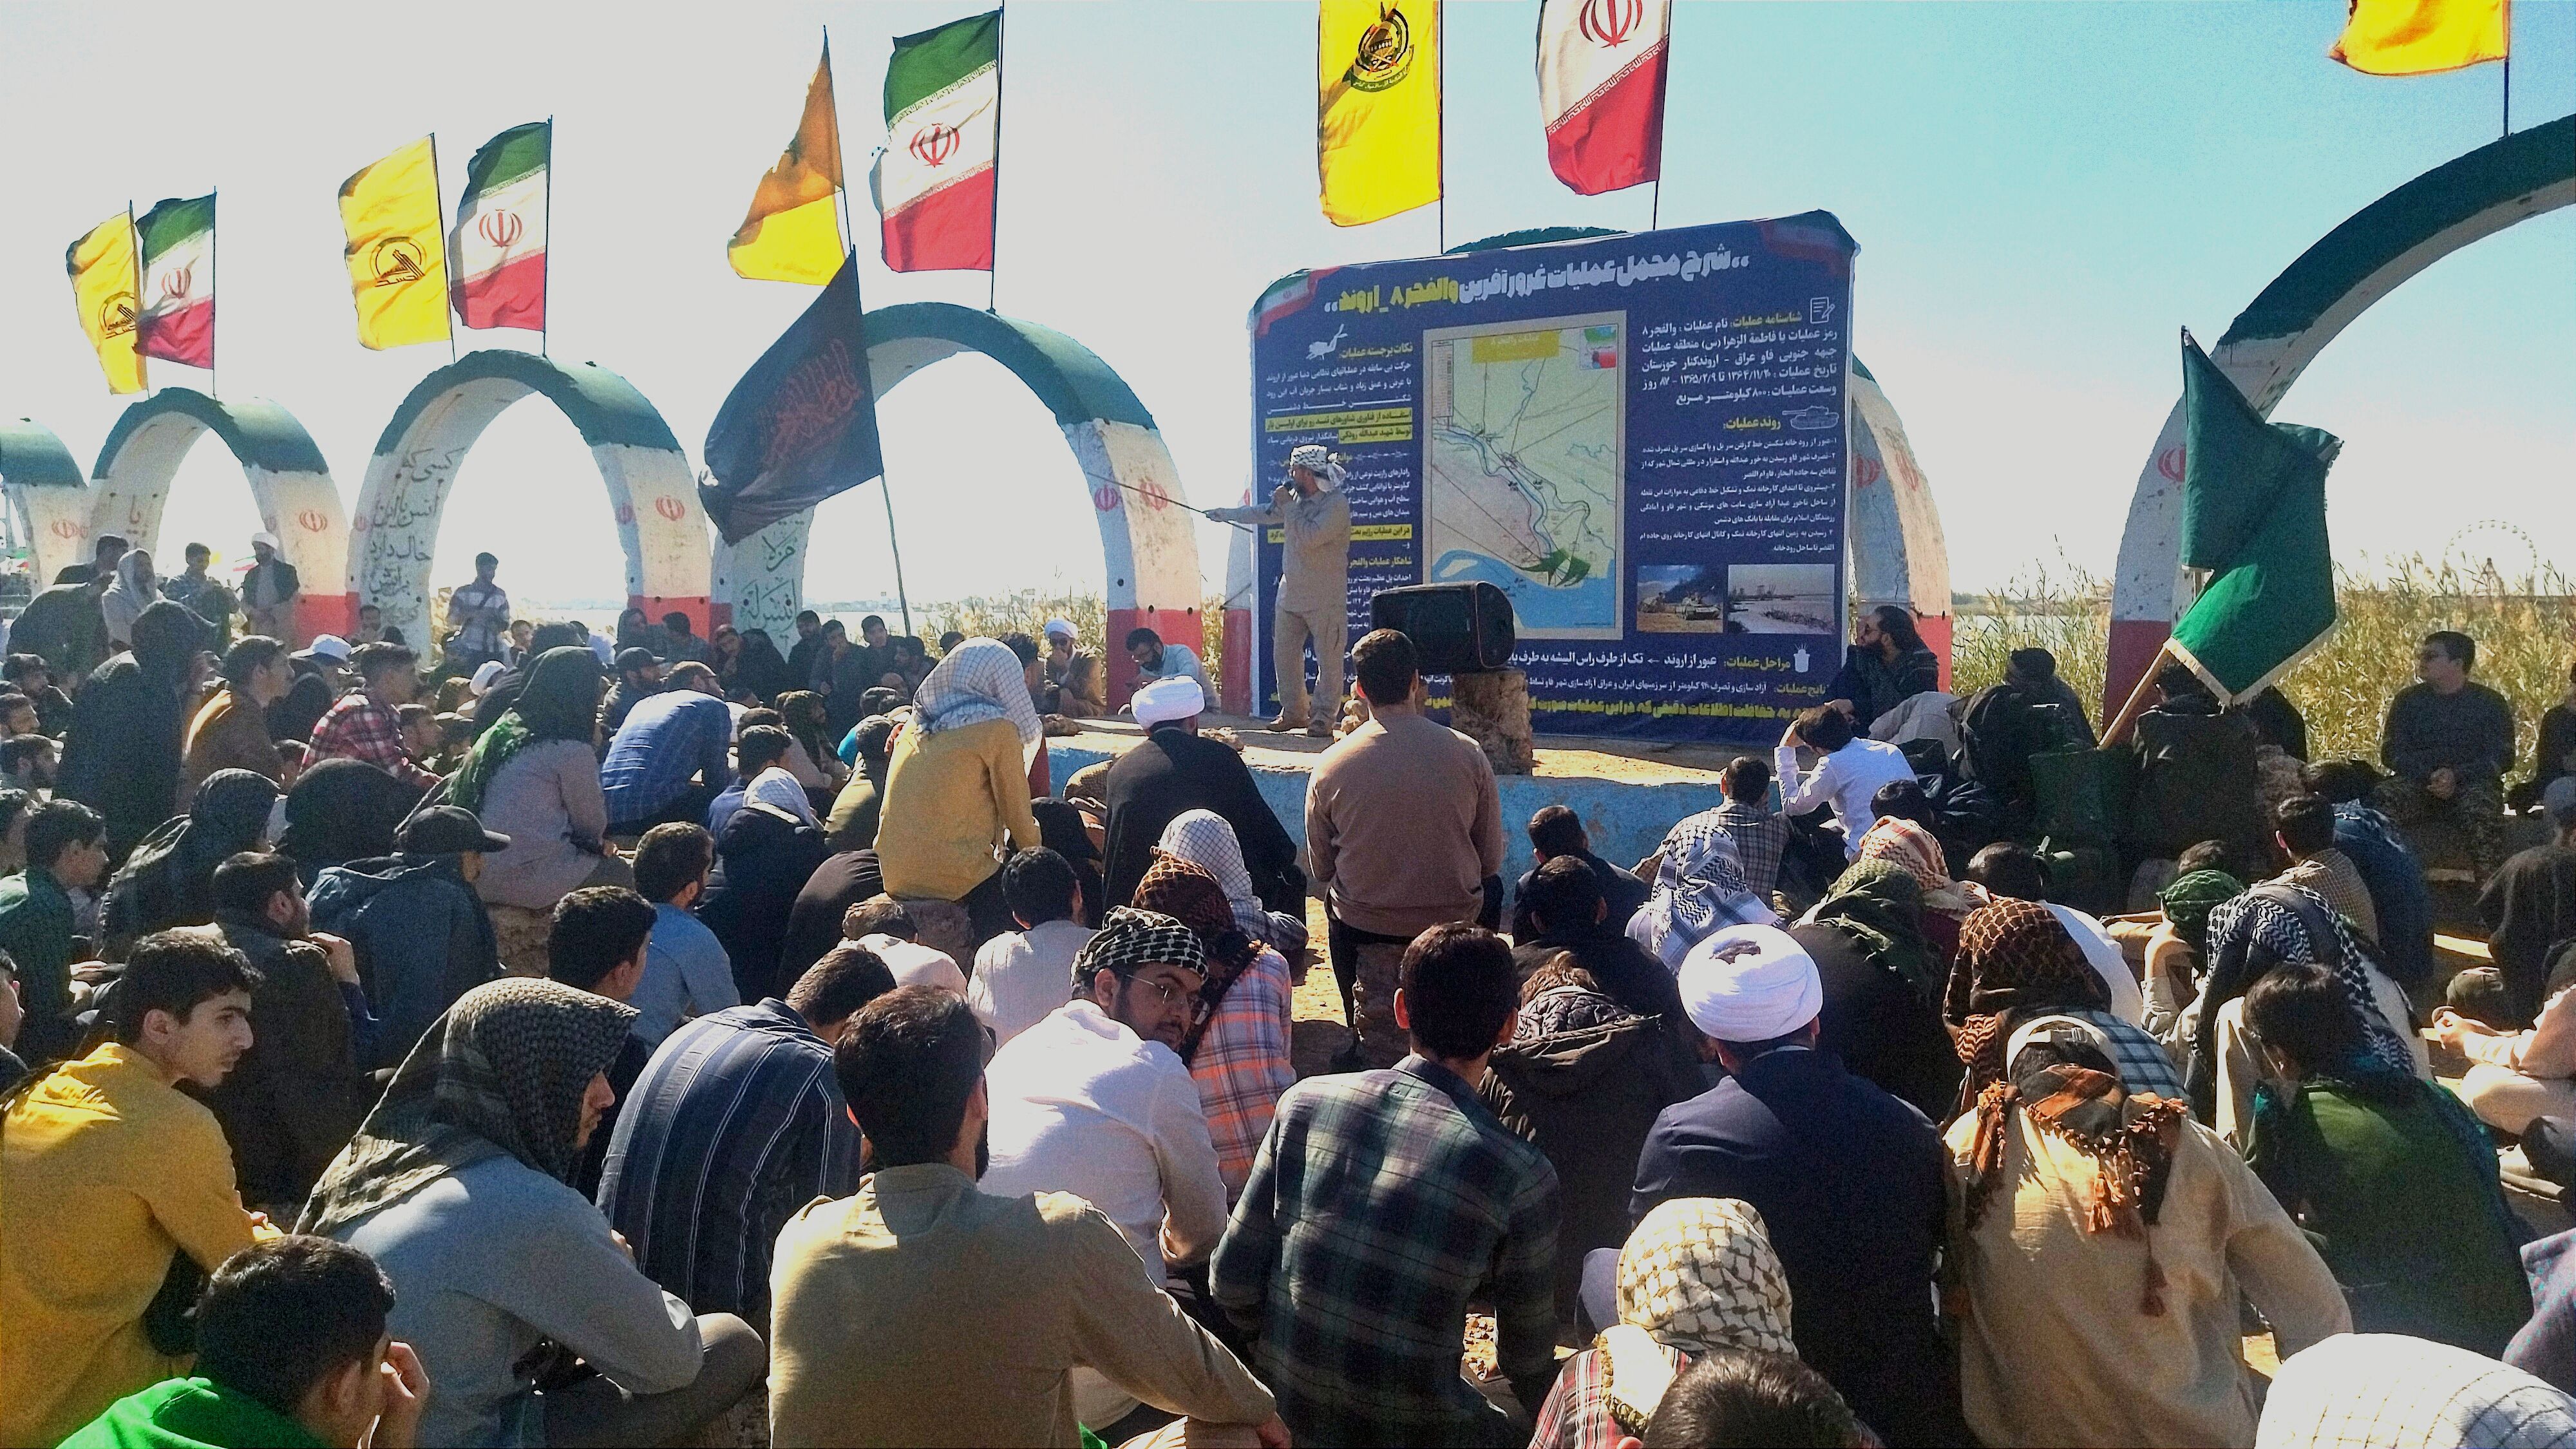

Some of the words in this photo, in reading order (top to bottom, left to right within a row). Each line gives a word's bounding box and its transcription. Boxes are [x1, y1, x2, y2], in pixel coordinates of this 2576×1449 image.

[1547, 260, 1616, 290] عملیات
[1616, 253, 1680, 287] مجمل
[1459, 269, 1508, 304] آفرین
[1507, 263, 1546, 298] غرور
[1404, 277, 1459, 309] والفجر
[1765, 310, 1803, 325] شناسنامه
[1642, 325, 1648, 336] ۸
[1648, 322, 1677, 338] والفجر
[1714, 317, 1728, 333] نام
[1778, 330, 1786, 344] یا
[1788, 328, 1821, 343] عملیات
[1822, 328, 1837, 341] رمز
[1393, 341, 1414, 353] نکات
[1642, 341, 1671, 355] عملیات
[1673, 337, 1700, 350] منطقه
[1723, 333, 1747, 350] الزهرا
[1367, 346, 1394, 357] برجسته
[1760, 348, 1774, 365] فاو
[1779, 349, 1809, 363] جنوبی
[1814, 347, 1837, 359] جبهه
[1642, 357, 1678, 372] خوزستان
[1681, 354, 1719, 370] اروندکنار
[1735, 352, 1756, 366] عراق
[1359, 366, 1367, 375] در
[1384, 363, 1394, 374] بی
[1394, 361, 1412, 372] حرکت
[1813, 363, 1837, 378] تاریخ
[1718, 371, 1725, 382] تا
[1642, 378, 1658, 391] روز
[1808, 384, 1837, 396] وسعت
[1759, 415, 1781, 431] روند
[1689, 488, 1707, 497] دفاعی
[1719, 486, 1738, 495] تشکیل
[1368, 556, 1391, 567] عملیات
[1518, 650, 1539, 665] طرف
[1540, 654, 1550, 665] به
[1575, 652, 1595, 667] راس
[1596, 652, 1618, 667] طرف
[1617, 652, 1627, 667] از
[1627, 652, 1644, 664] تک
[1663, 653, 1687, 668] اروند
[1687, 654, 1697, 669] از
[1696, 656, 1718, 669] عبور
[1759, 656, 1791, 672] مراحل
[1545, 677, 1554, 688] فاو
[1555, 677, 1567, 689] شهر
[1597, 680, 1613, 690] عراق
[1618, 679, 1635, 690] ایران
[1668, 680, 1676, 692] از
[1678, 681, 1701, 692] کیلومتر
[1710, 681, 1731, 692] تصرف
[1736, 681, 1755, 694] سازی
[1755, 681, 1767, 694] آزاد
